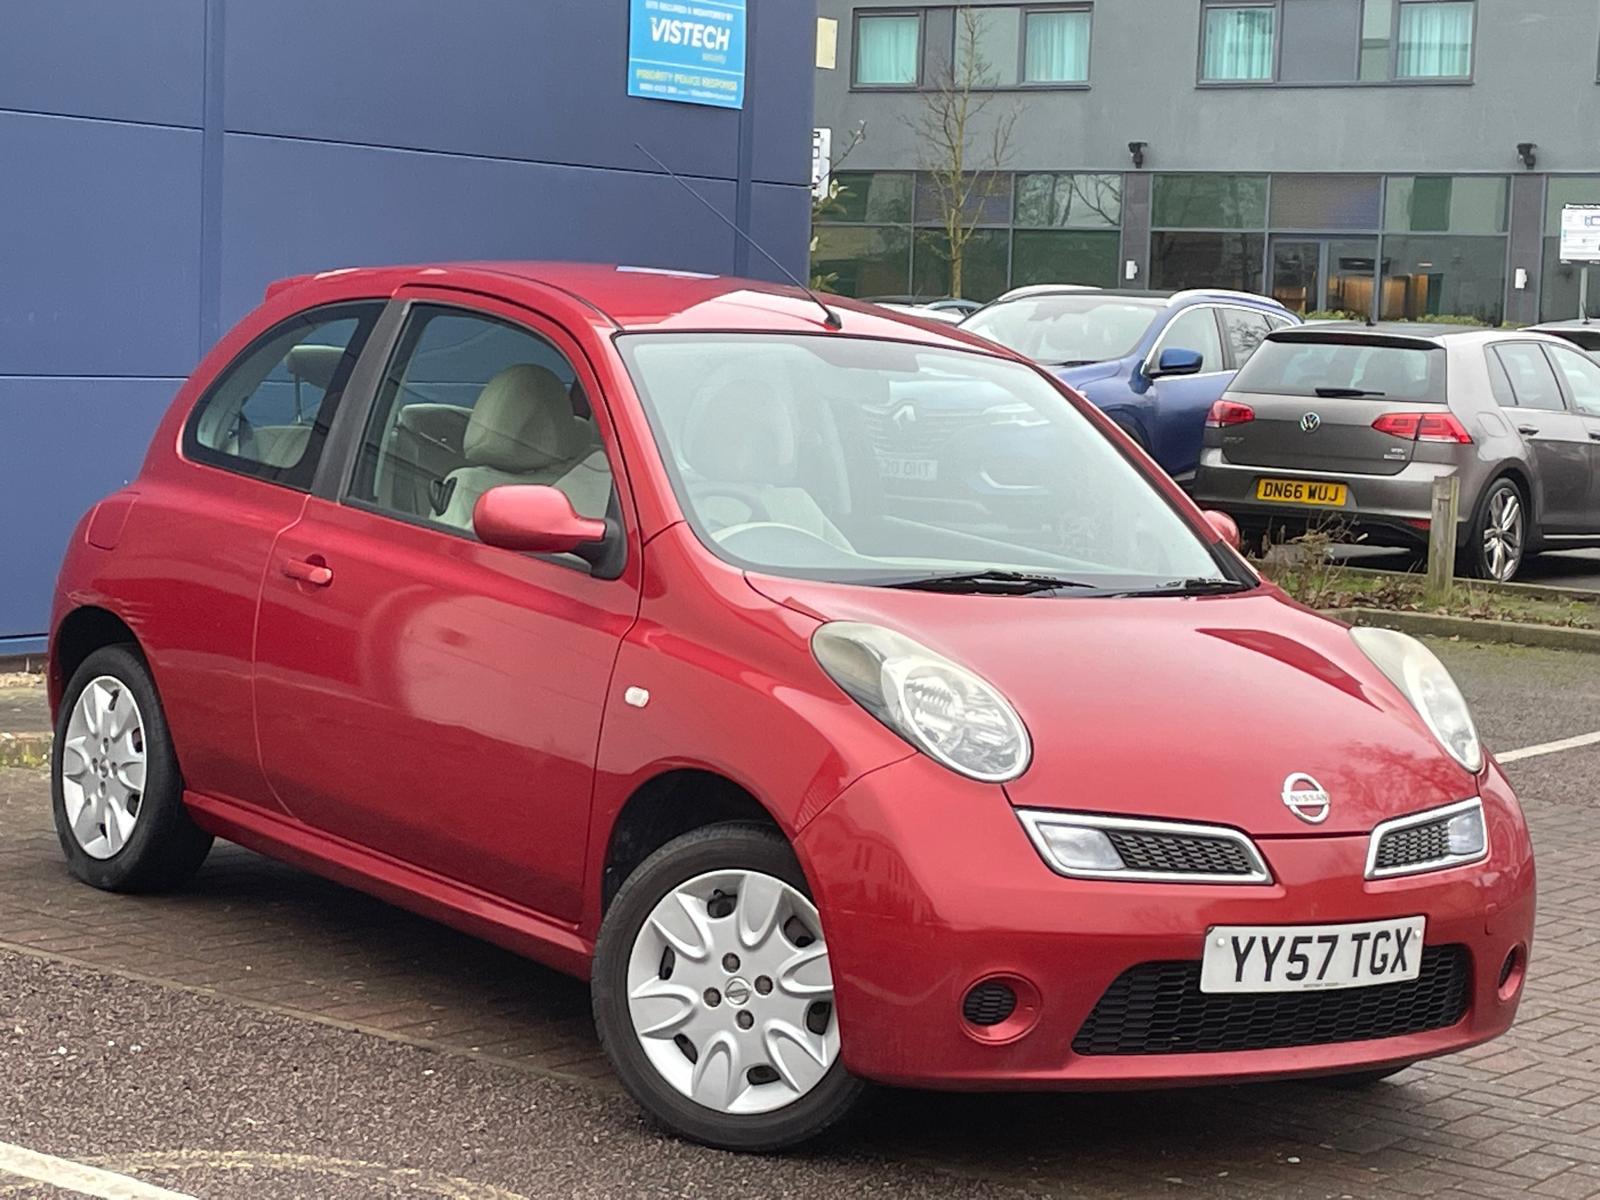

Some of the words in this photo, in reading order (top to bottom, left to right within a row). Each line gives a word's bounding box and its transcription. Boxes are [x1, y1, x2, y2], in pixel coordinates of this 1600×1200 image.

[650, 16, 731, 51] VISTECH
[1263, 482, 1303, 499] DN66
[1308, 485, 1340, 502] WUJ
[1231, 934, 1340, 982] YY57
[1351, 926, 1413, 978] TGX
